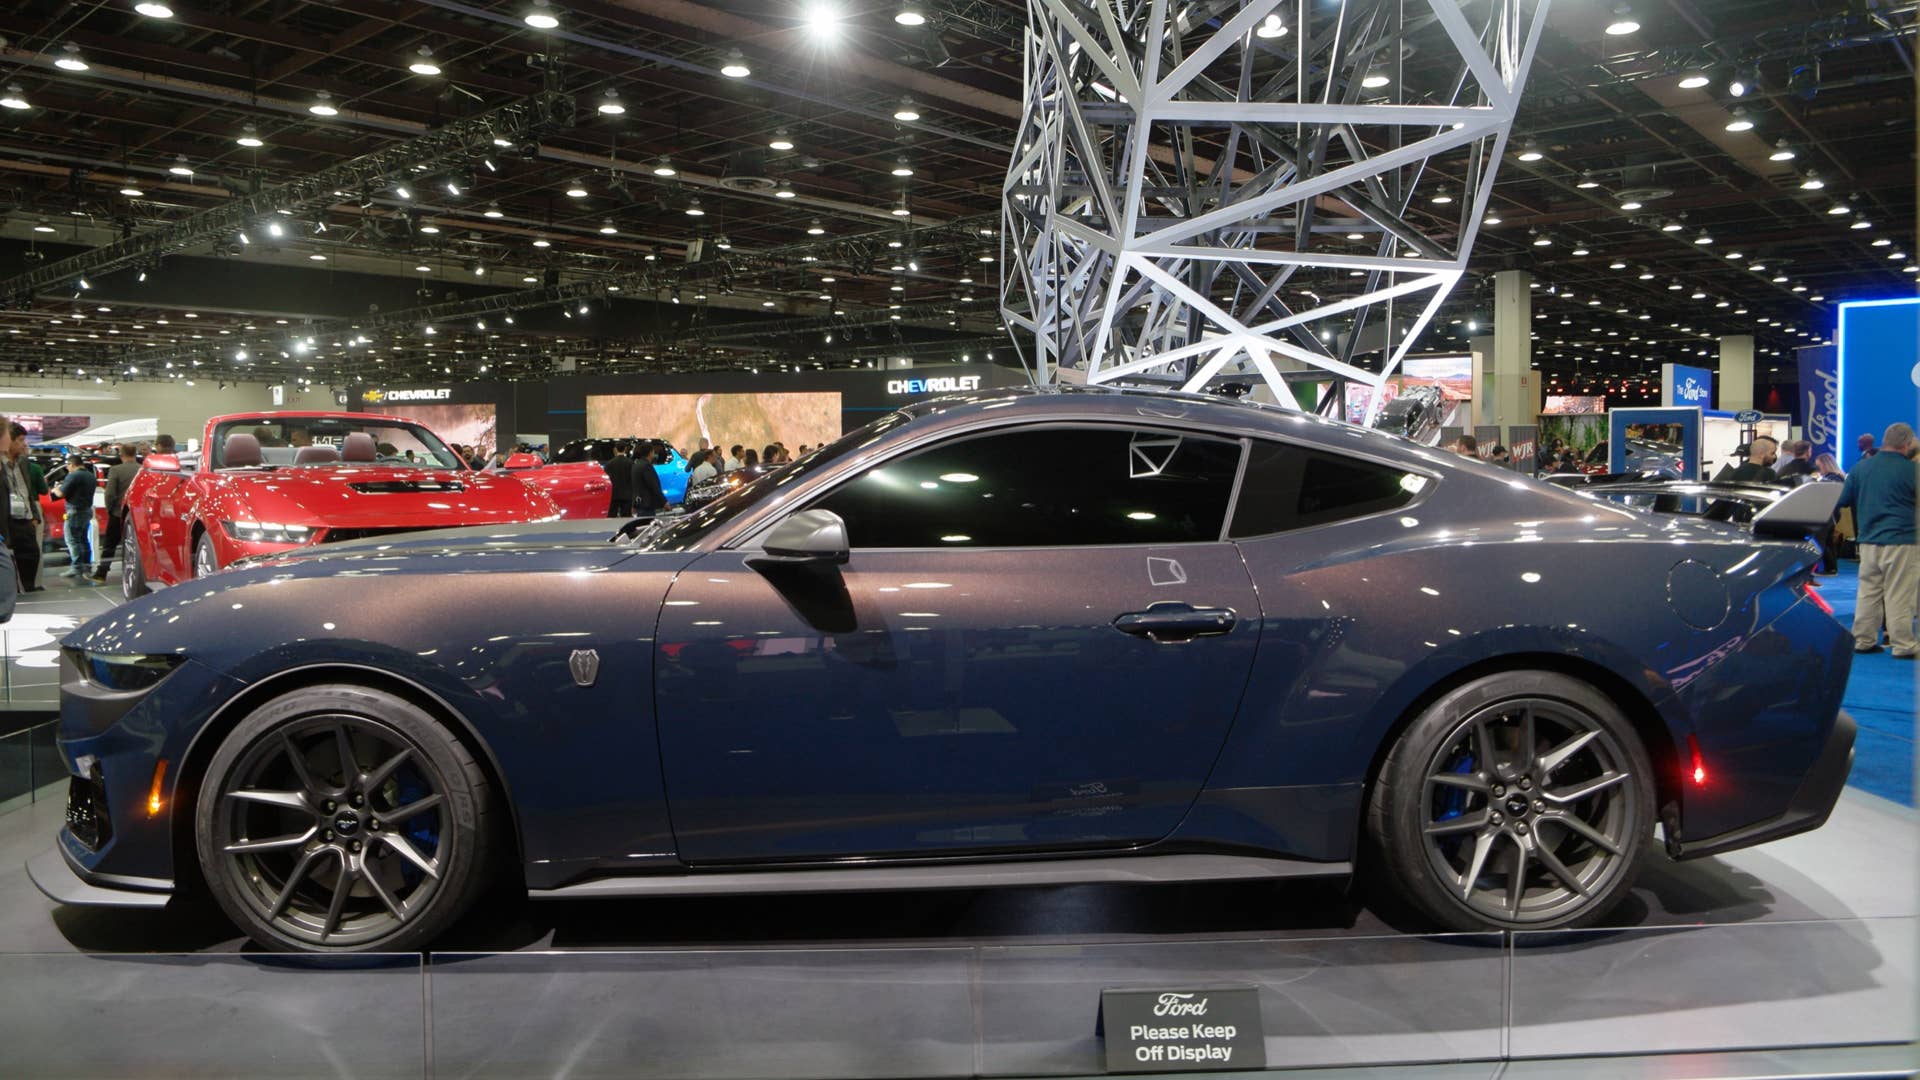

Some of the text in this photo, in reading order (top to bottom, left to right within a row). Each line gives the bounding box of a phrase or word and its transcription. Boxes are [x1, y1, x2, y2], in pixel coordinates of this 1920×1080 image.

[887, 375, 981, 394] CHEVROLET
[1684, 377, 1700, 401] Ford
[388, 388, 452, 401] CHEVROLET
[1512, 441, 1534, 460] WJR
[1153, 992, 1209, 1017] Ford
[1130, 1023, 1237, 1041] Please Keep
[1135, 1044, 1233, 1063] Off Display
